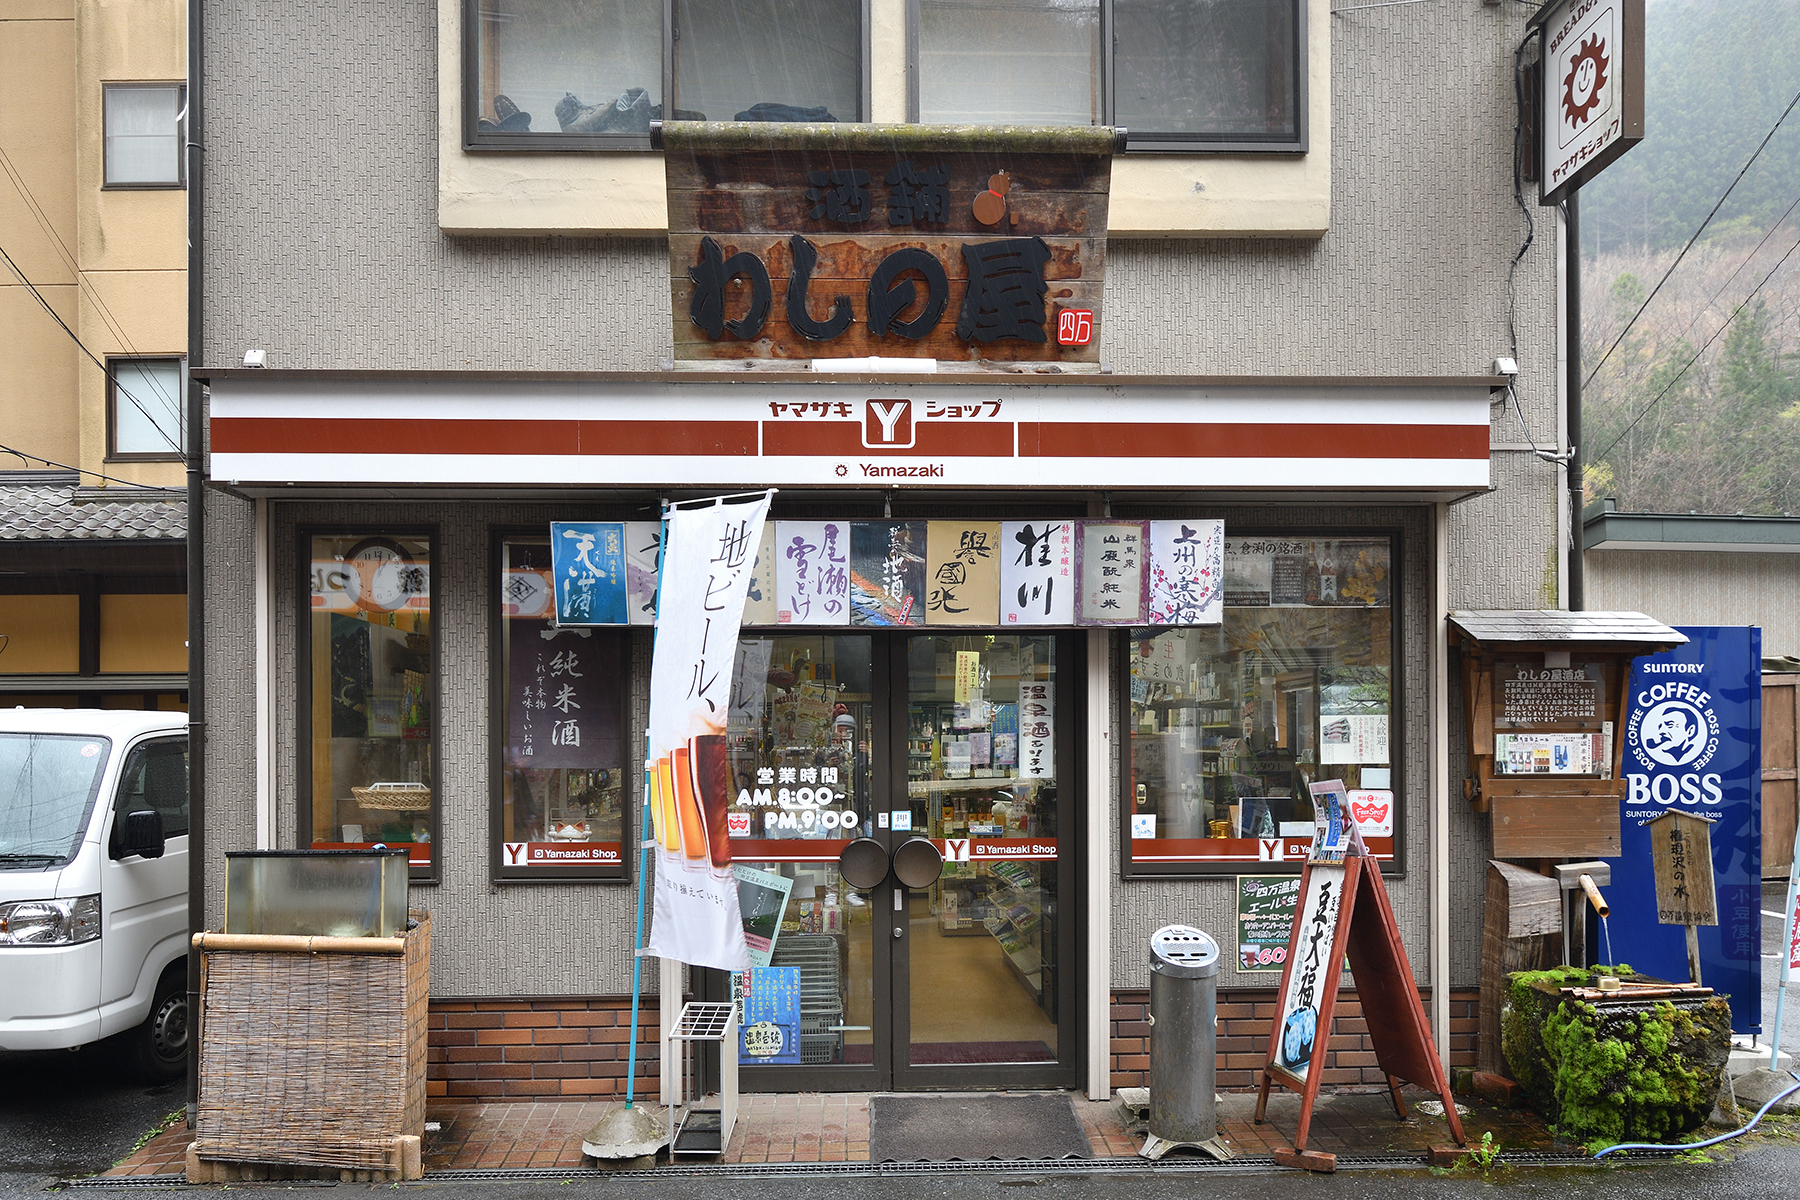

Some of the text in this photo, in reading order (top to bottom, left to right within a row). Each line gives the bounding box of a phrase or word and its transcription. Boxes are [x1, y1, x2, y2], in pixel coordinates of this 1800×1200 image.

[1552, 115, 1620, 183] ヤマザキショップ
[687, 232, 1054, 344] わしの屋
[768, 398, 1003, 418] ヤマザキ ショップ
[870, 402, 908, 442] Y
[859, 462, 944, 478] Yamazaki
[786, 536, 817, 622] 雪どけ
[816, 523, 848, 618] 尾瀬の
[1014, 523, 1062, 616] 桂川
[535, 652, 547, 710] これぞ本物
[1517, 669, 1585, 681] わしの屋酒店
[1643, 663, 1705, 674] SUNTORY
[549, 650, 584, 747] 純米酒
[1638, 682, 1711, 709] COFFEE
[522, 686, 534, 756] 美味しいお酒
[1628, 708, 1656, 771] BOSS COFFEE
[1692, 708, 1720, 772] BOSS COFFEE
[757, 767, 838, 785] 営業時間
[1626, 773, 1723, 805] BOSS
[765, 810, 859, 830] PM.9:00
[505, 844, 617, 864] Y Yamazaki Shop
[948, 839, 1057, 861] Y Yamazaki Shop
[1261, 839, 1283, 861] Y
[1256, 879, 1301, 898] 四万温泉
[1259, 946, 1287, 966] 60
[1298, 880, 1332, 1010] 豆大福
